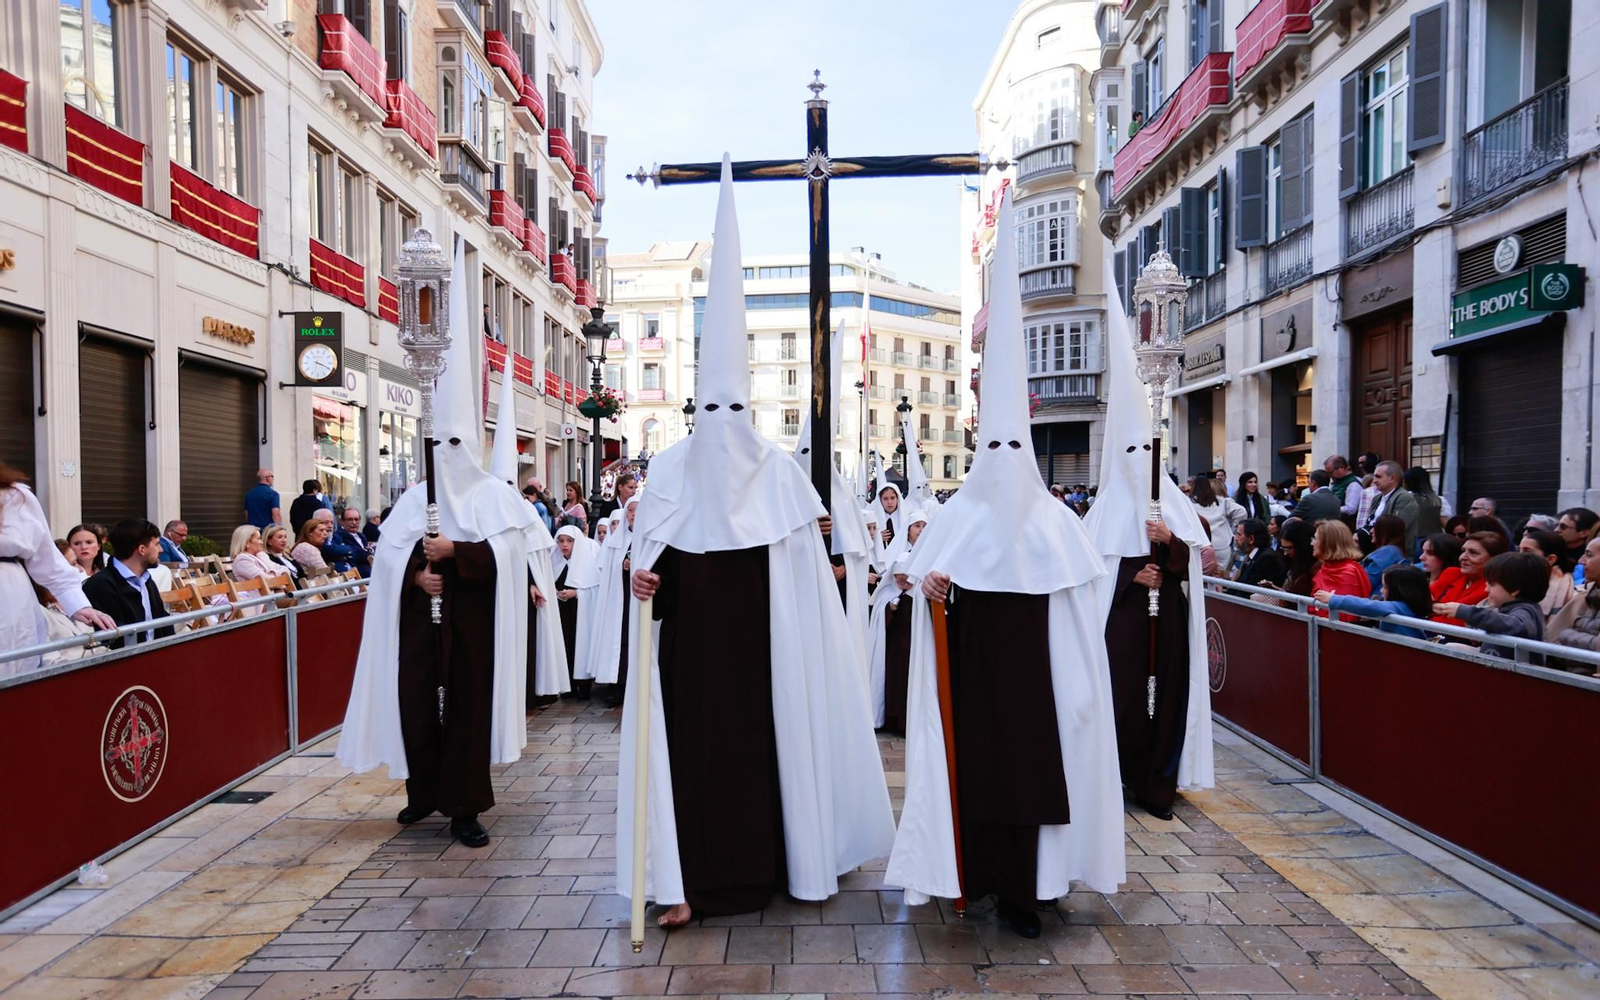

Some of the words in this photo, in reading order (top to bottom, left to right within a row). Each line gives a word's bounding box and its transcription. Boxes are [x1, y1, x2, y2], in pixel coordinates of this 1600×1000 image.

[1453, 303, 1477, 322] THE
[1480, 290, 1518, 316] BODY
[301, 328, 335, 336] ROLEX
[387, 383, 413, 406] KIKO
